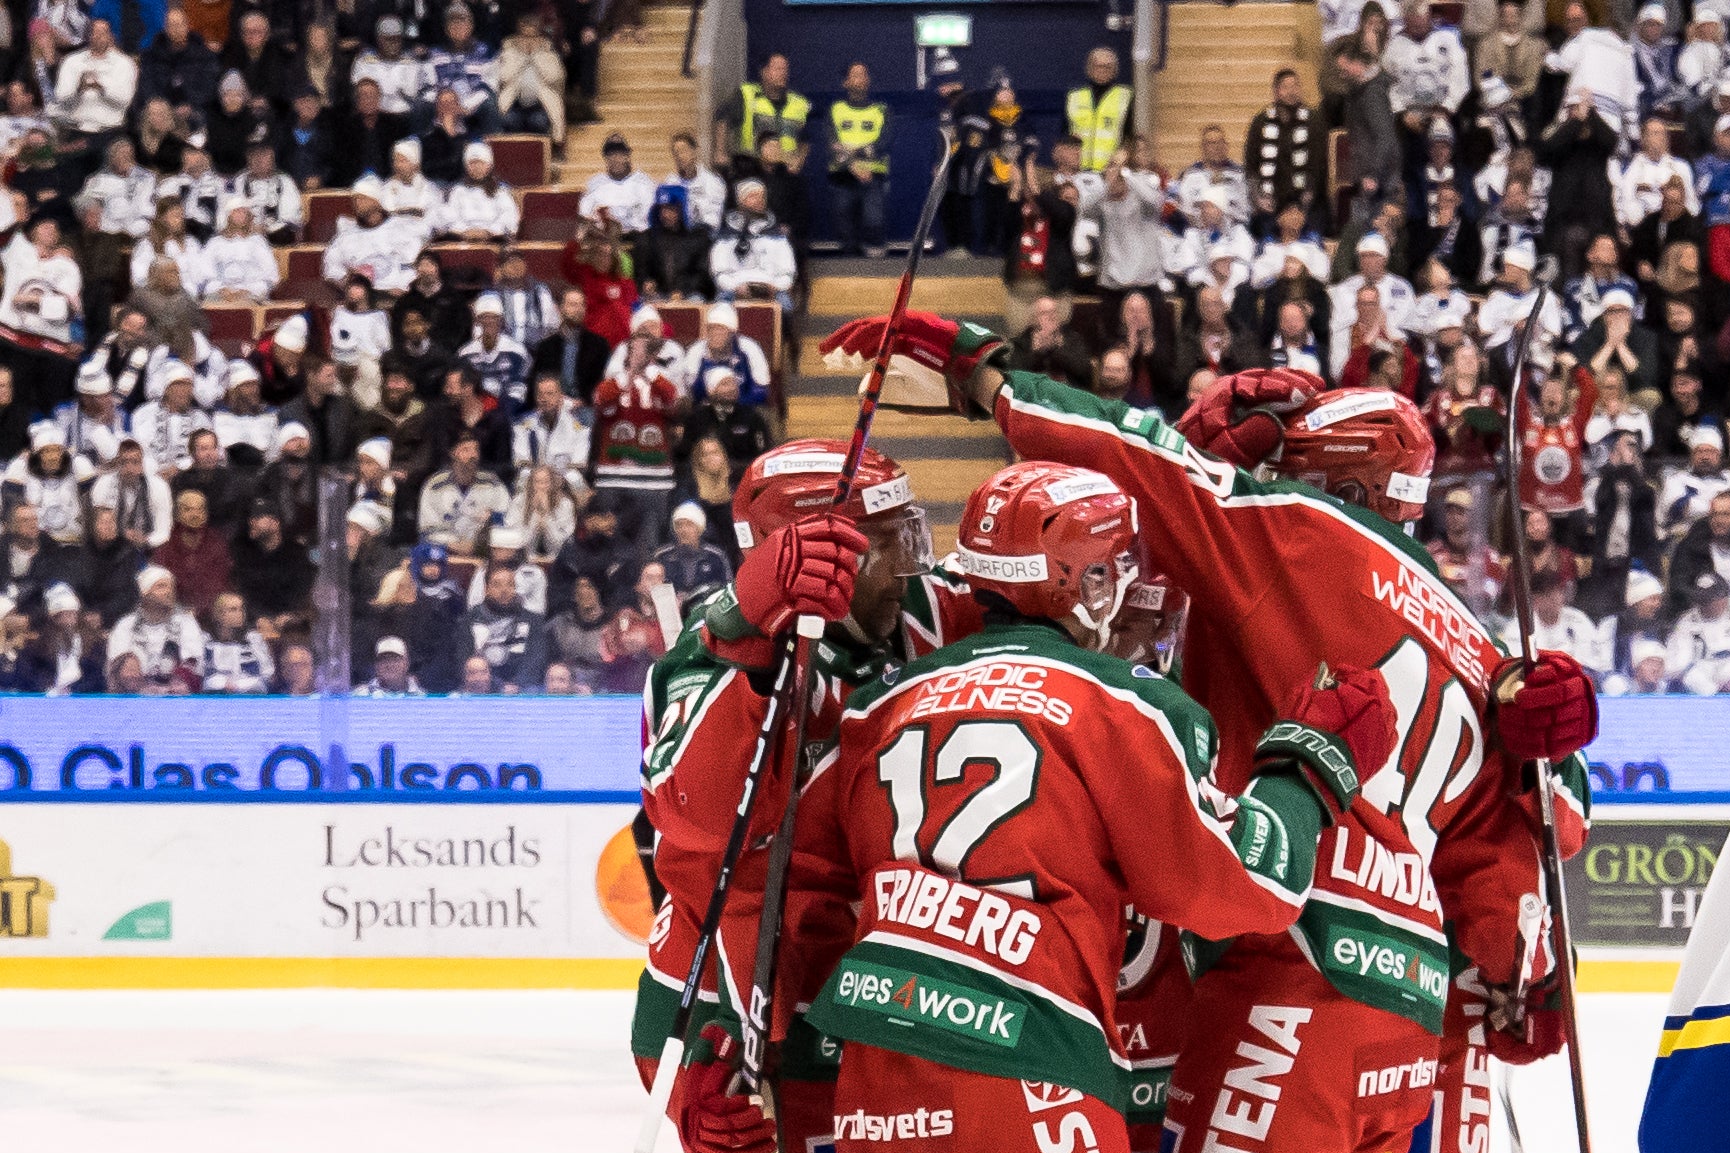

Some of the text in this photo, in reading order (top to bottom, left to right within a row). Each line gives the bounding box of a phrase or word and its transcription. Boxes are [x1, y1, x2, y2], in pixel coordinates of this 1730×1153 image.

[1397, 563, 1484, 658] NORDIC
[918, 662, 1048, 698] NORDIC
[878, 721, 1041, 900] 12
[321, 823, 542, 868] Leksands
[319, 884, 539, 941] Sparbank
[838, 968, 1017, 1040] eyes4work
[833, 1106, 955, 1142] rdsvets
